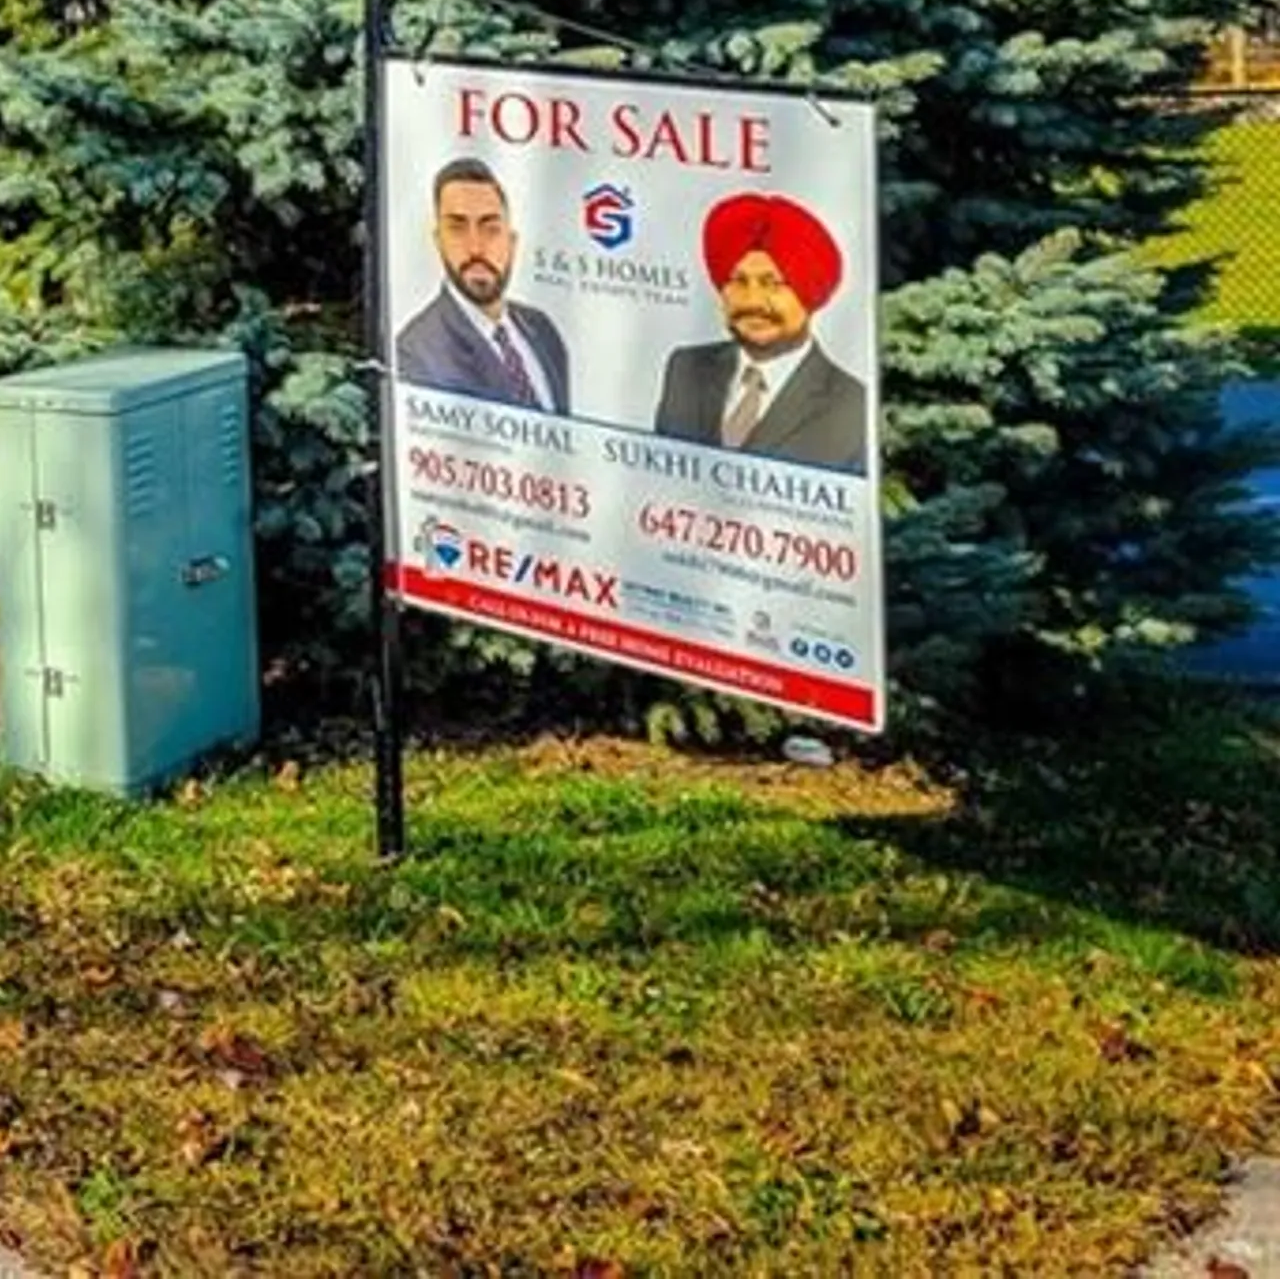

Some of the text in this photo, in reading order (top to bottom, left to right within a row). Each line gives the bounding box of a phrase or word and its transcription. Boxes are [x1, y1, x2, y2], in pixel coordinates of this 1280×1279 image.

[459, 89, 772, 173] FOR SALE
[534, 248, 690, 290] S & S HOMES
[406, 395, 475, 431] SAMY
[482, 411, 575, 455] SOHAL
[409, 445, 592, 520] 905.703.0813
[603, 438, 701, 483] SUKHI
[711, 460, 855, 515] CHAHAL
[467, 539, 618, 609] RE/MAX
[639, 501, 857, 583] 647.270.7900
